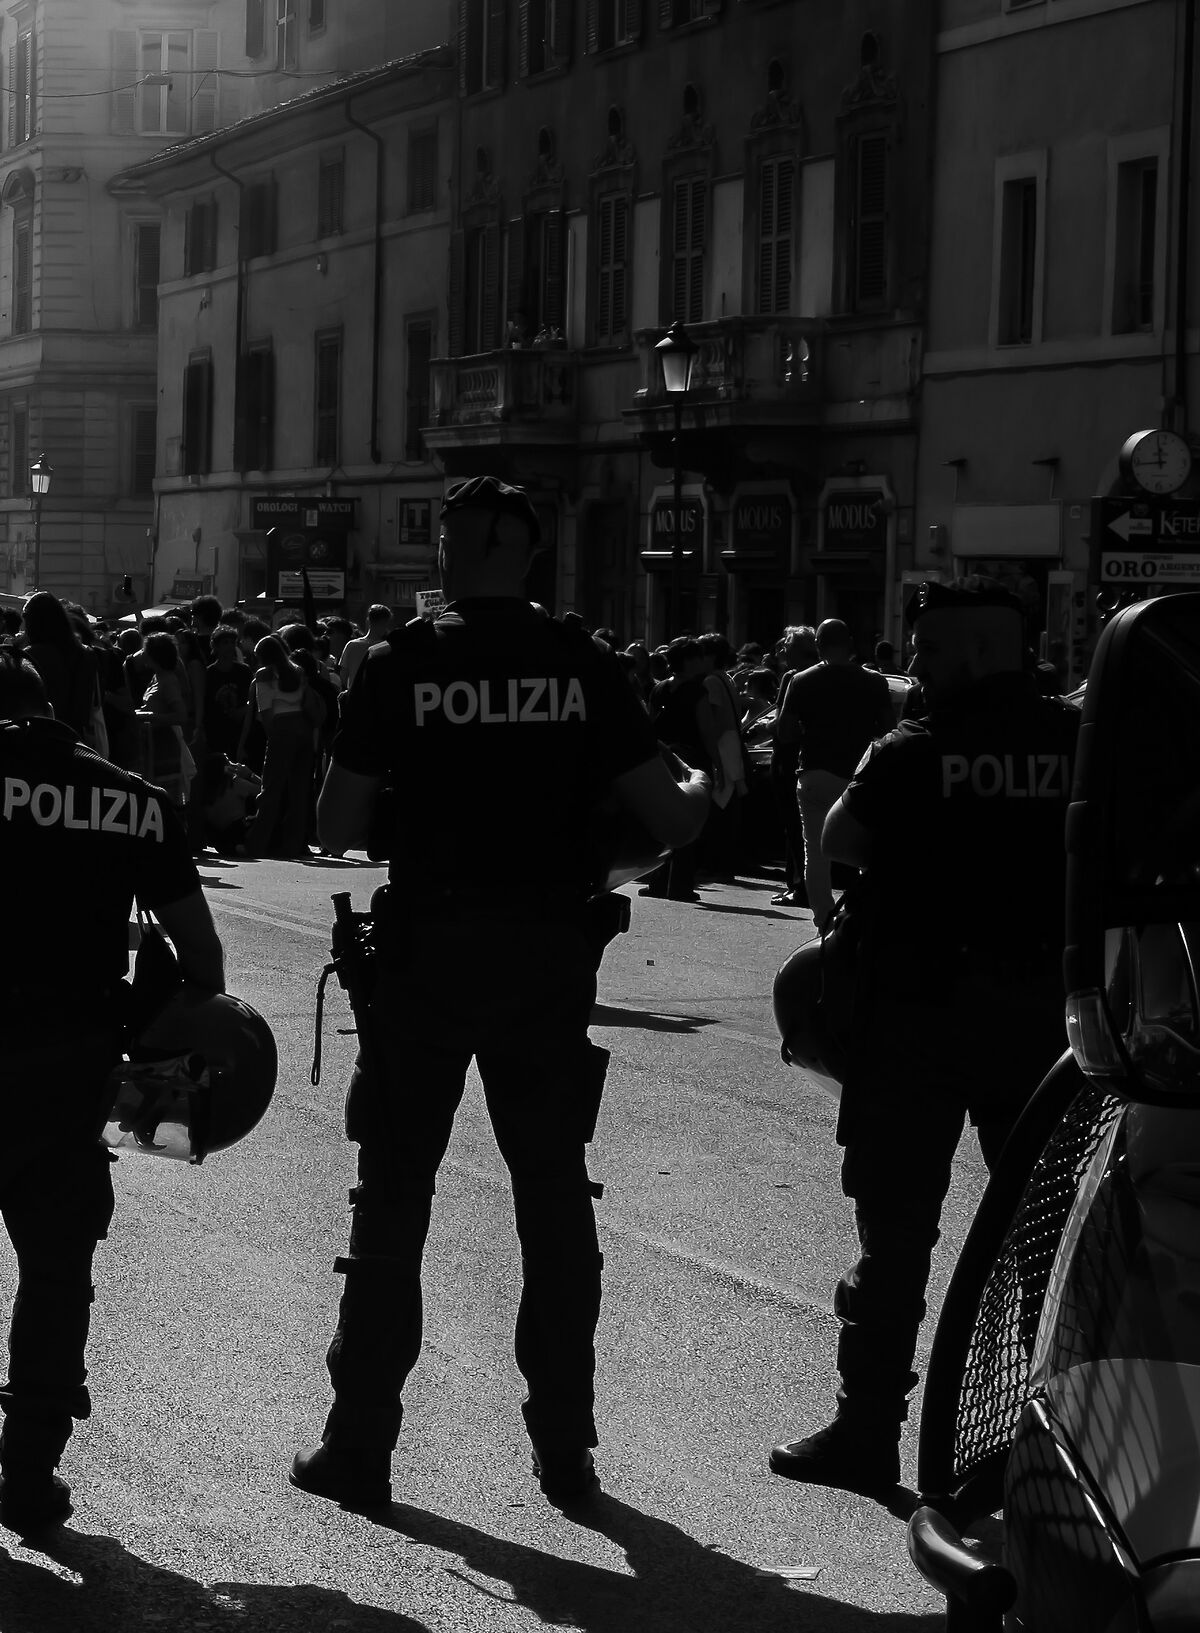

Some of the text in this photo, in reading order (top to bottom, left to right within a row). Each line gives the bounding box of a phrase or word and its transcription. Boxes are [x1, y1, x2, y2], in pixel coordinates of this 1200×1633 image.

[256, 502, 351, 513] OROLOGI WATCH
[737, 504, 783, 529] MODUS
[828, 503, 877, 529] MODUS
[656, 509, 697, 533] MOUS
[1105, 560, 1157, 577] ORO
[413, 677, 587, 727] POLIZIA
[940, 753, 1071, 799] POLIZI
[3, 777, 165, 843] POLIZIA
